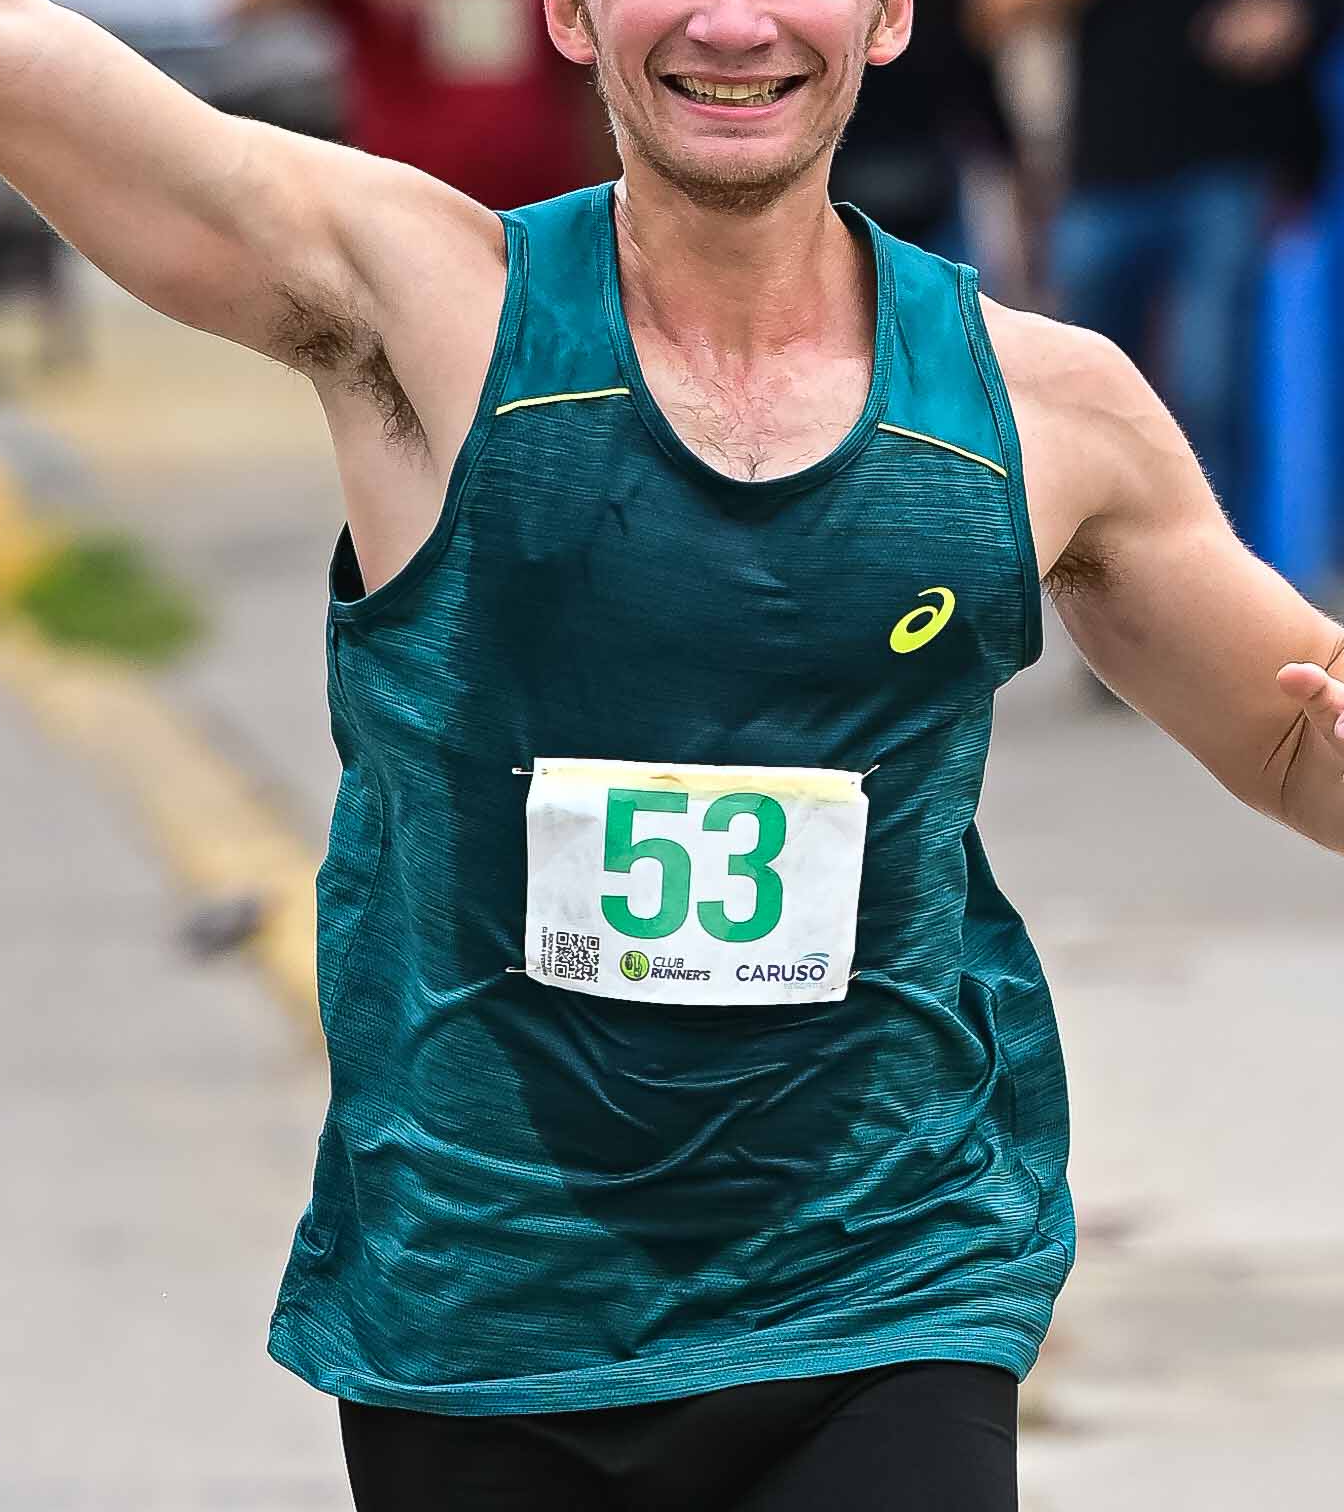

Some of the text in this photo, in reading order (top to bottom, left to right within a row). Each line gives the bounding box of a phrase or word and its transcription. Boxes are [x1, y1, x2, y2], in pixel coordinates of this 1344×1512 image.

[600, 787, 787, 943] 53
[653, 956, 684, 968] CLUB
[736, 964, 826, 982] CARUSO
